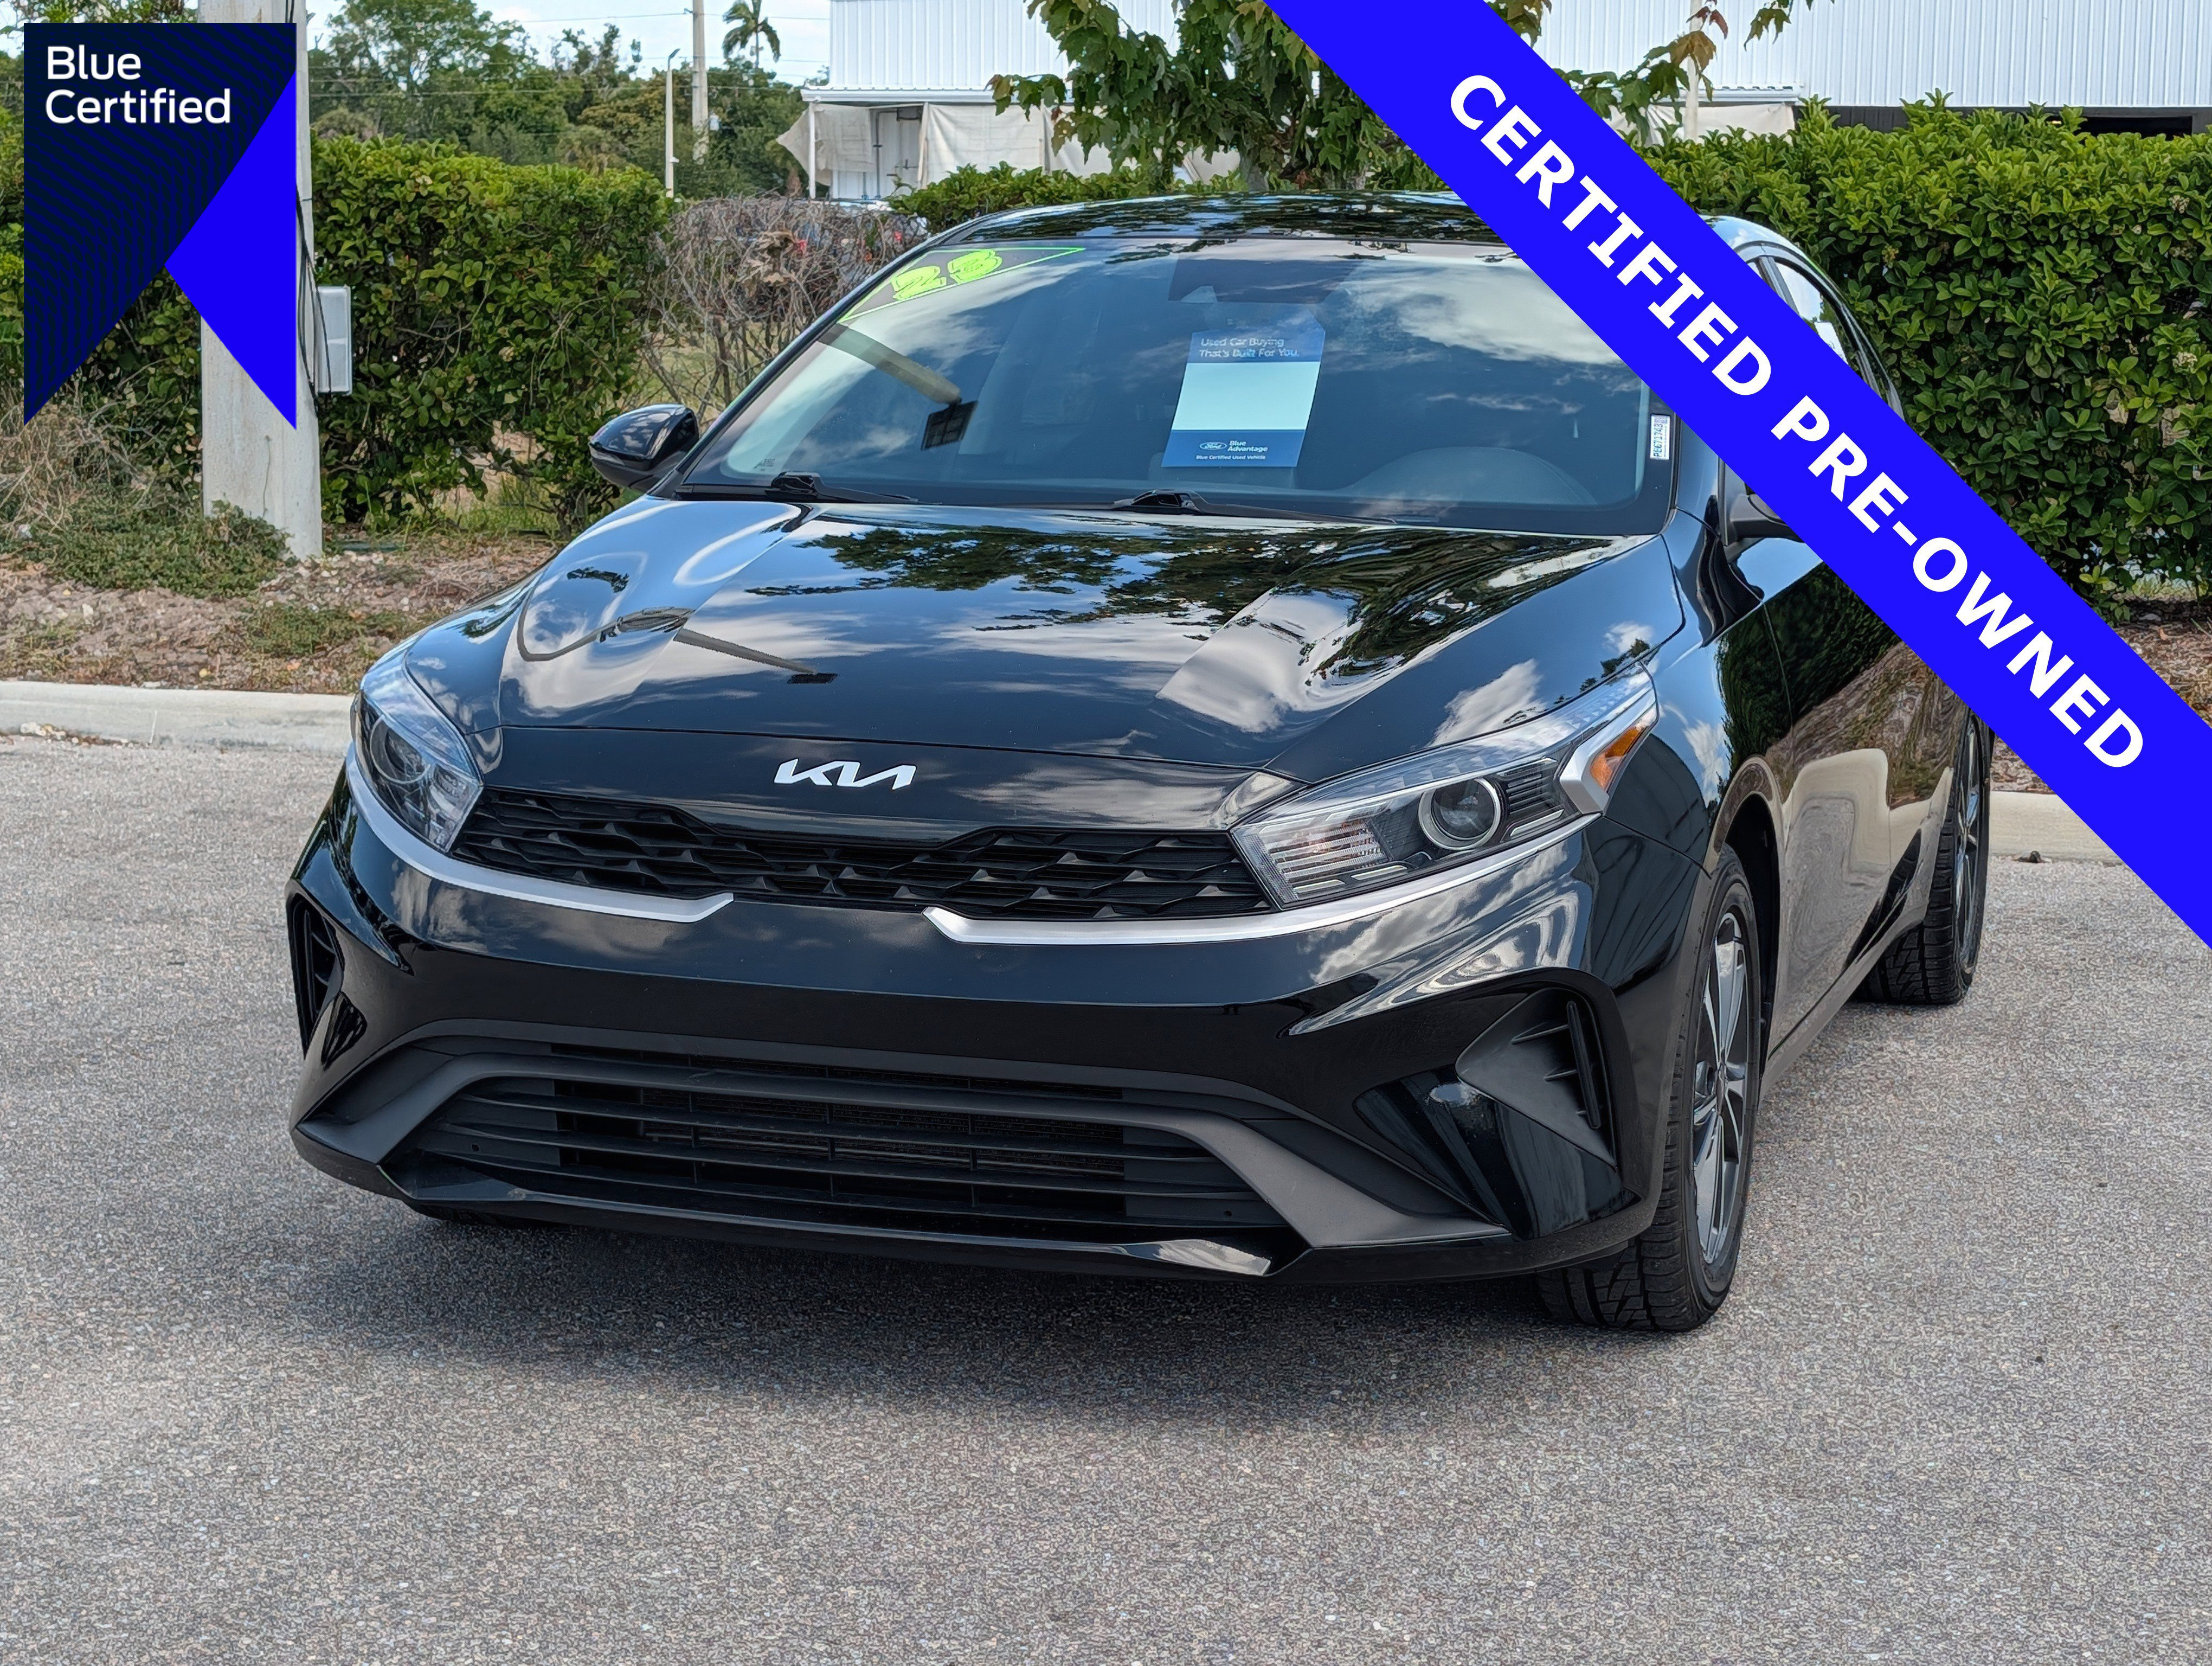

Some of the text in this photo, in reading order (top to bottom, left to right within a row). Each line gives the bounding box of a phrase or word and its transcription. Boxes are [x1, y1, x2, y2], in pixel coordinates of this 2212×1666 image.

[1200, 337, 1284, 348] Used Car Buying
[1199, 348, 1300, 358] That's Built For You.
[774, 758, 917, 790] KIA
